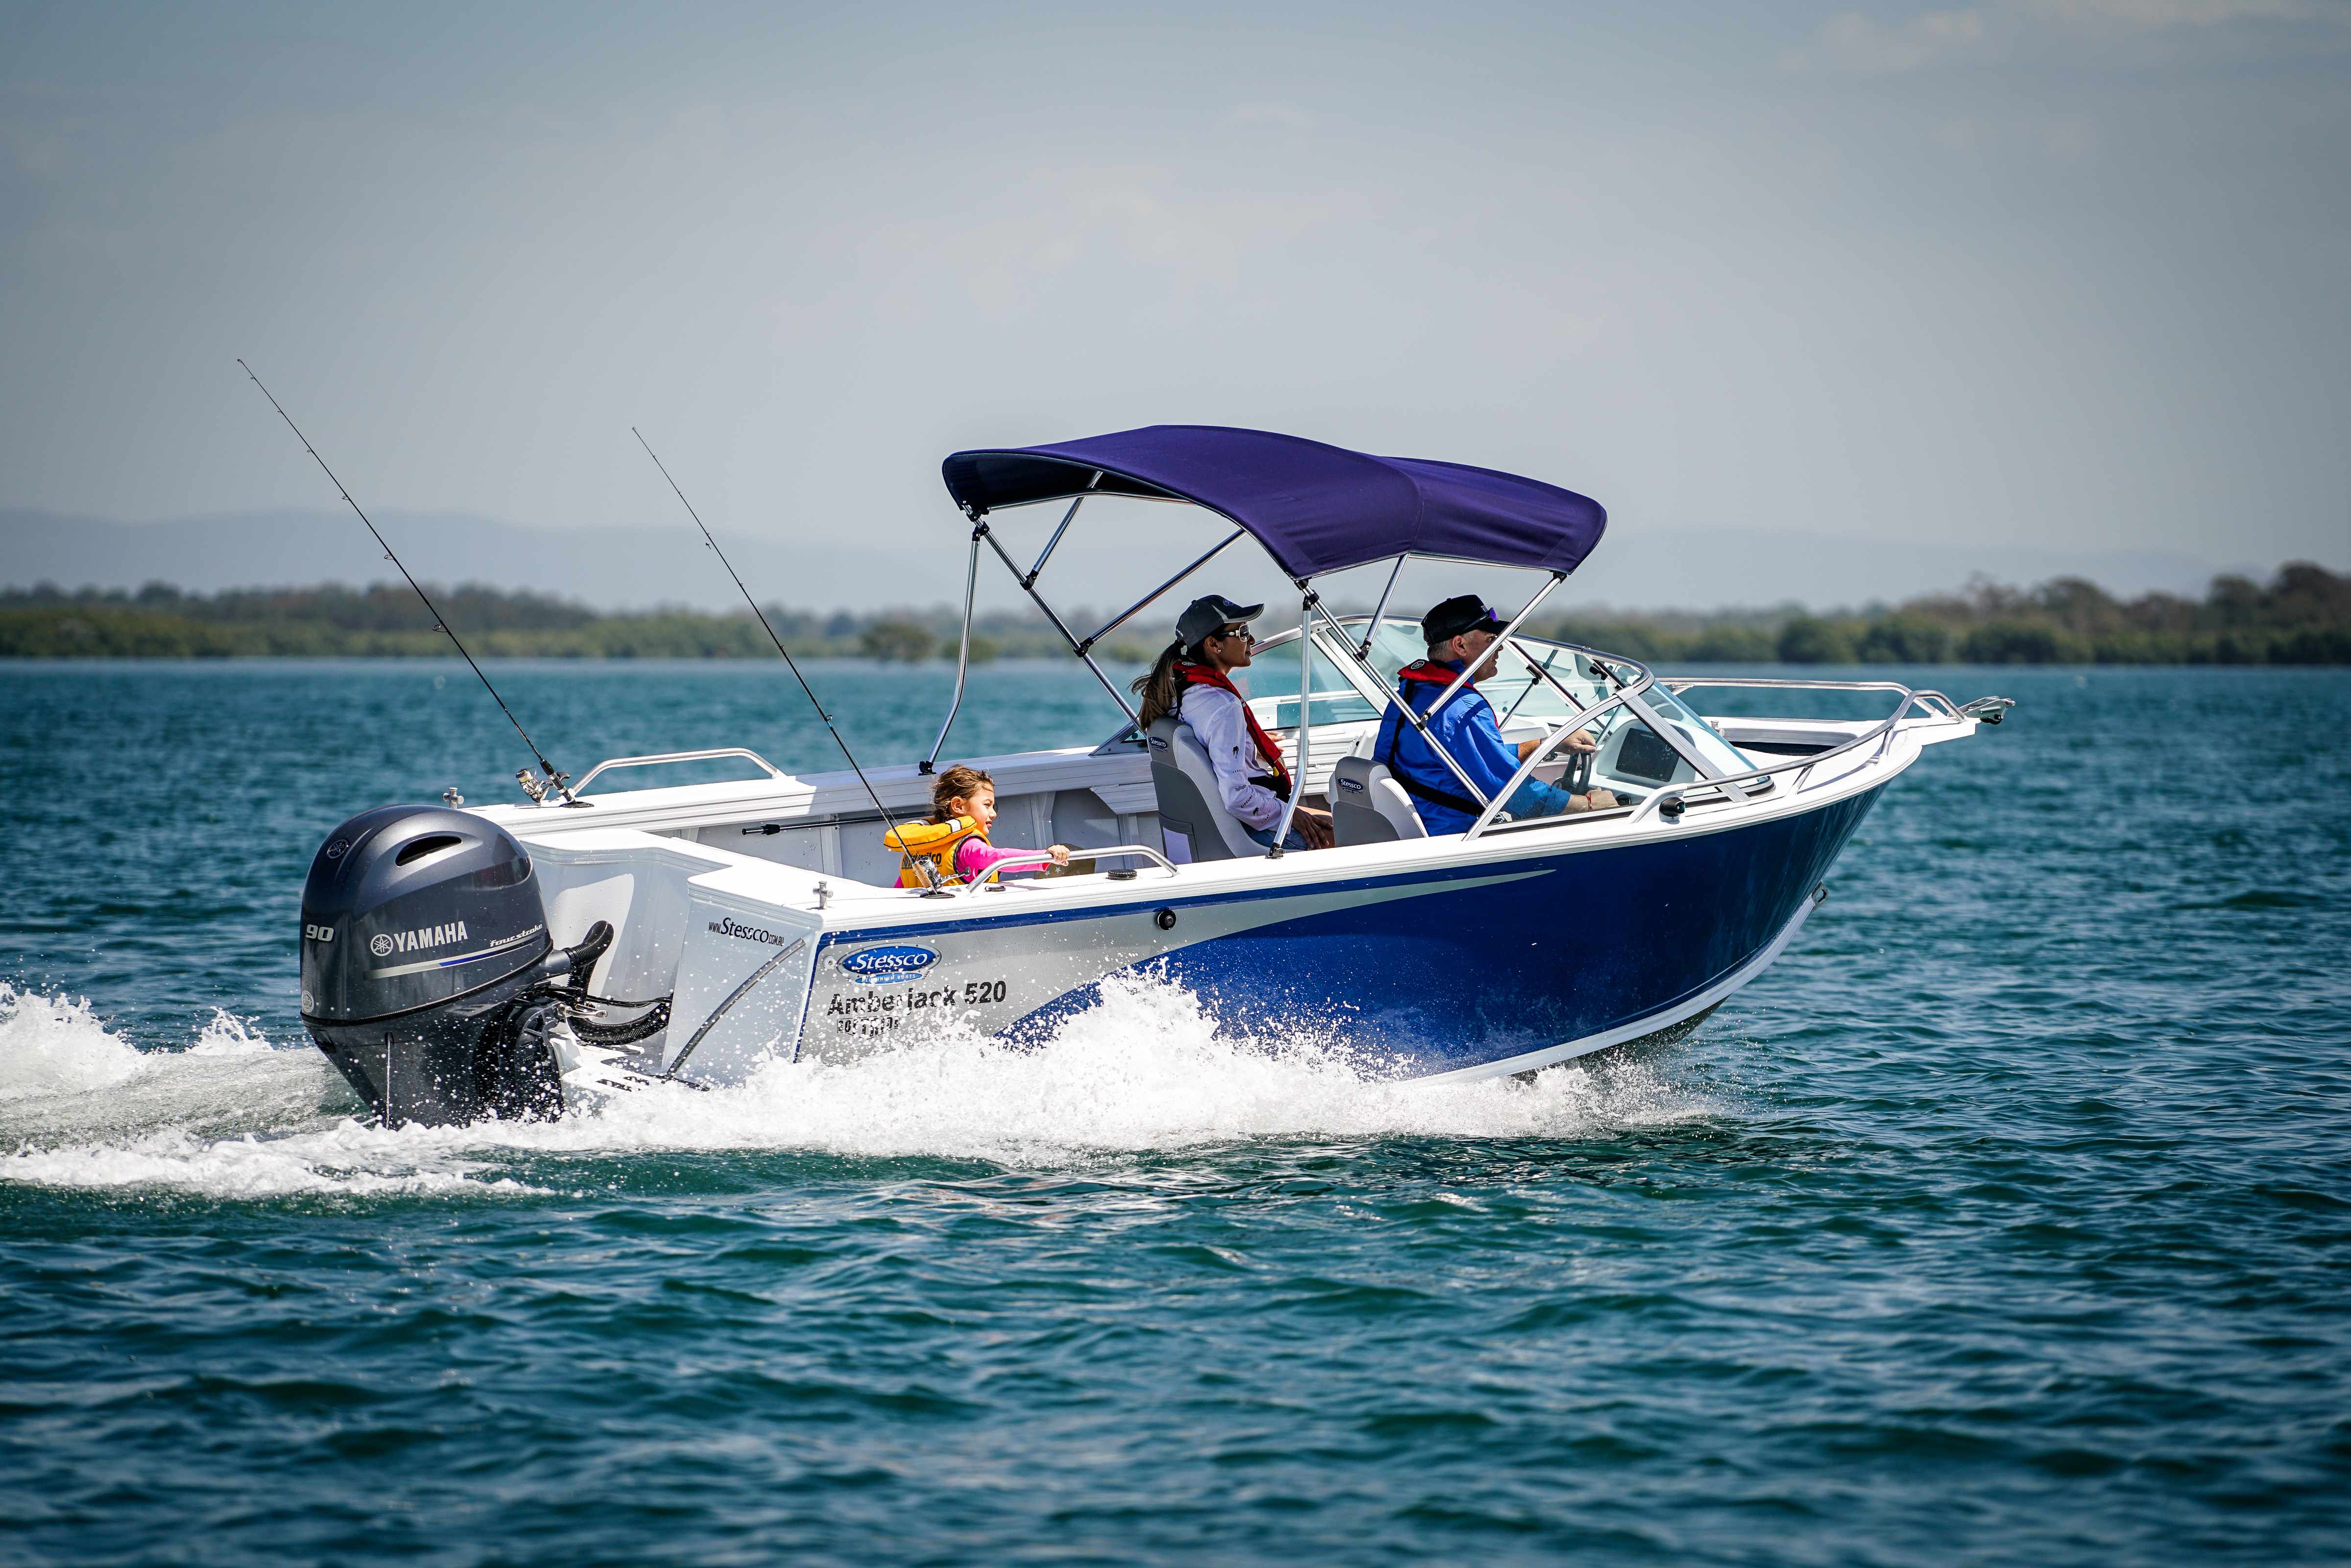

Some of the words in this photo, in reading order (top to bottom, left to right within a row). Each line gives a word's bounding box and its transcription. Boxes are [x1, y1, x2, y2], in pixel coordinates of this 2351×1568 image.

[1151, 737, 1166, 747] Stessco
[1341, 779, 1361, 789] Stessco
[306, 924, 334, 942] 90
[394, 921, 468, 952] YAMAHA
[855, 953, 928, 970] Stessco
[964, 980, 1006, 1004] 520
